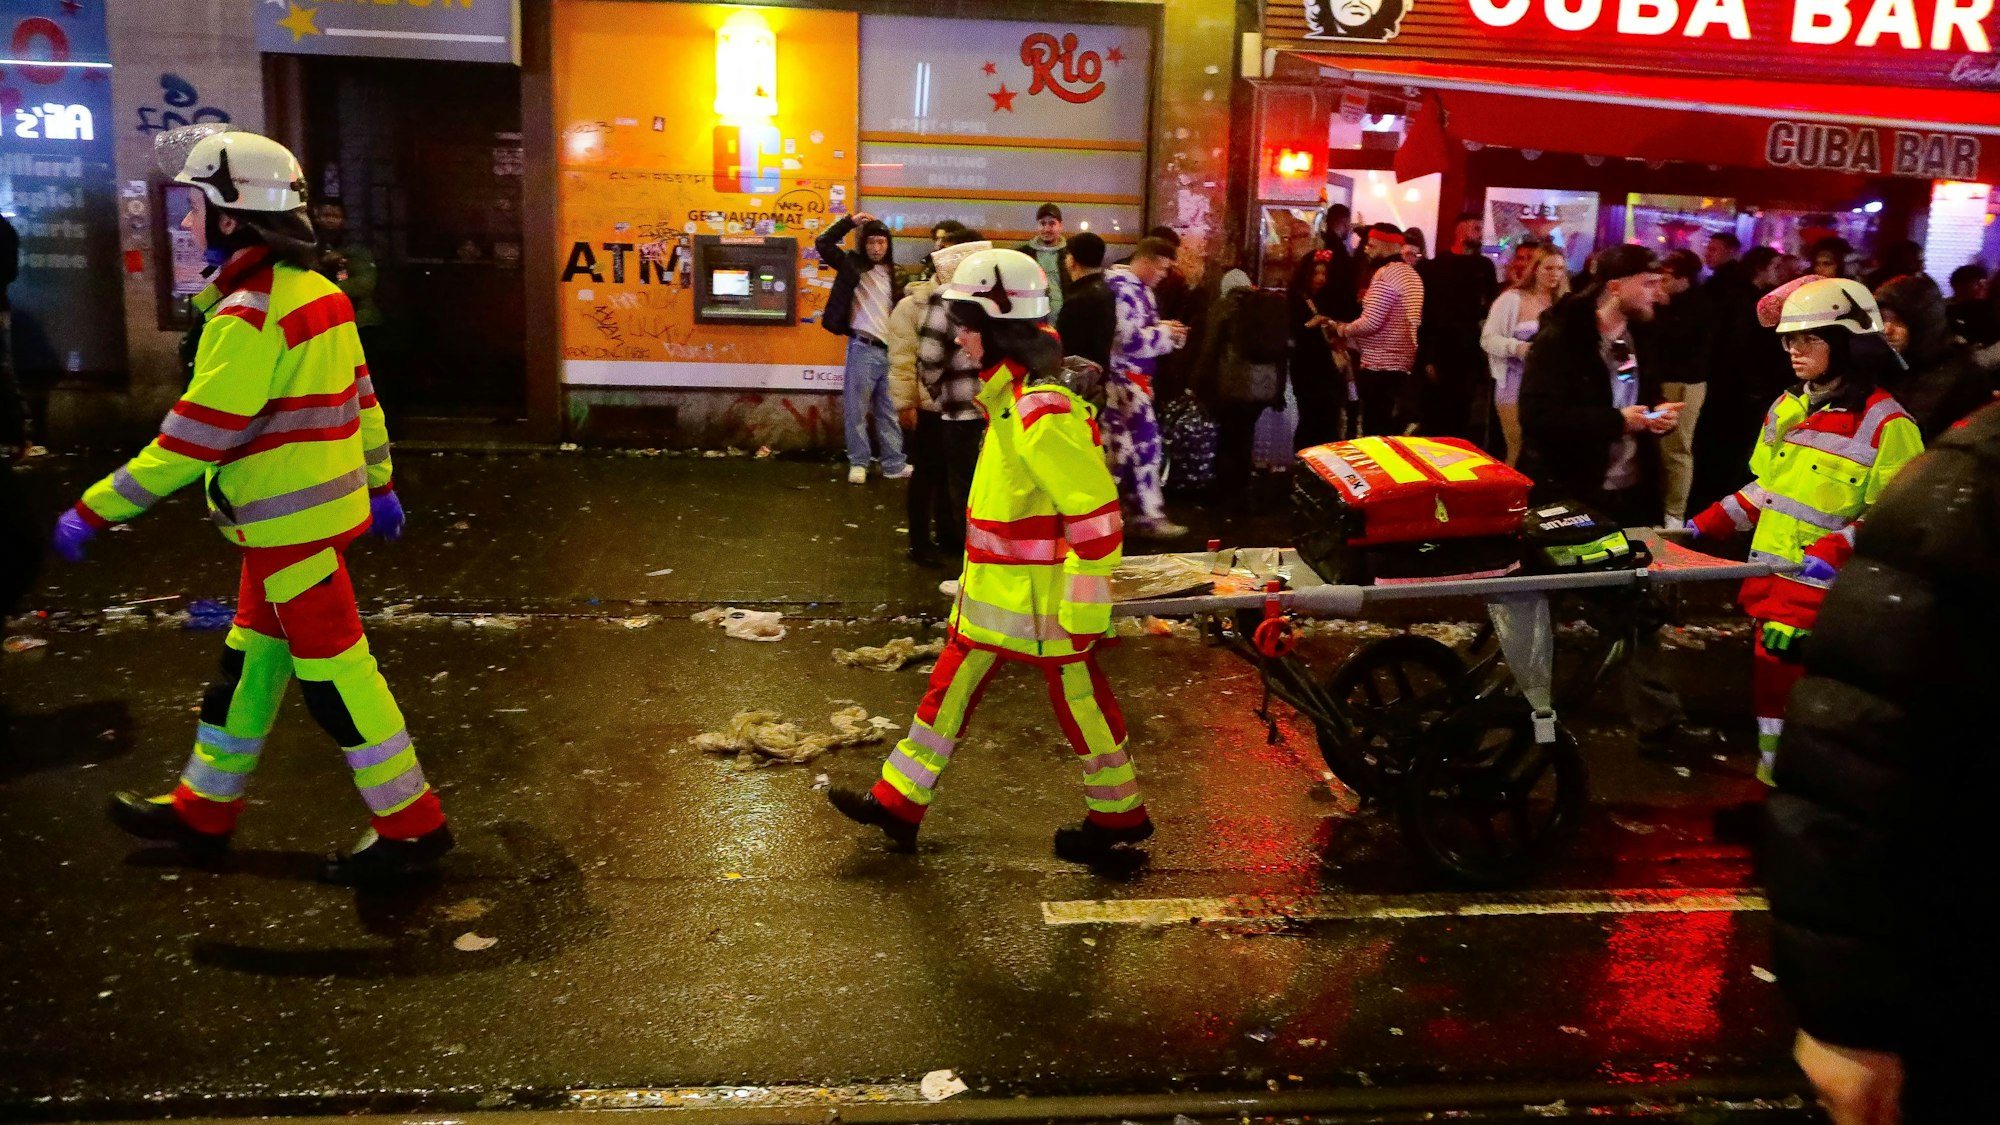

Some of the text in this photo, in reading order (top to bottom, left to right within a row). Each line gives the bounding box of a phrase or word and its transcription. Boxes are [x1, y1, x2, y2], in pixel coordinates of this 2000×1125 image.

[1790, 0, 1994, 53] BAR
[1020, 32, 1106, 104] Rio
[0, 154, 84, 178] illard
[1765, 120, 1981, 181] CUBA BAR
[562, 241, 691, 284] ATM
